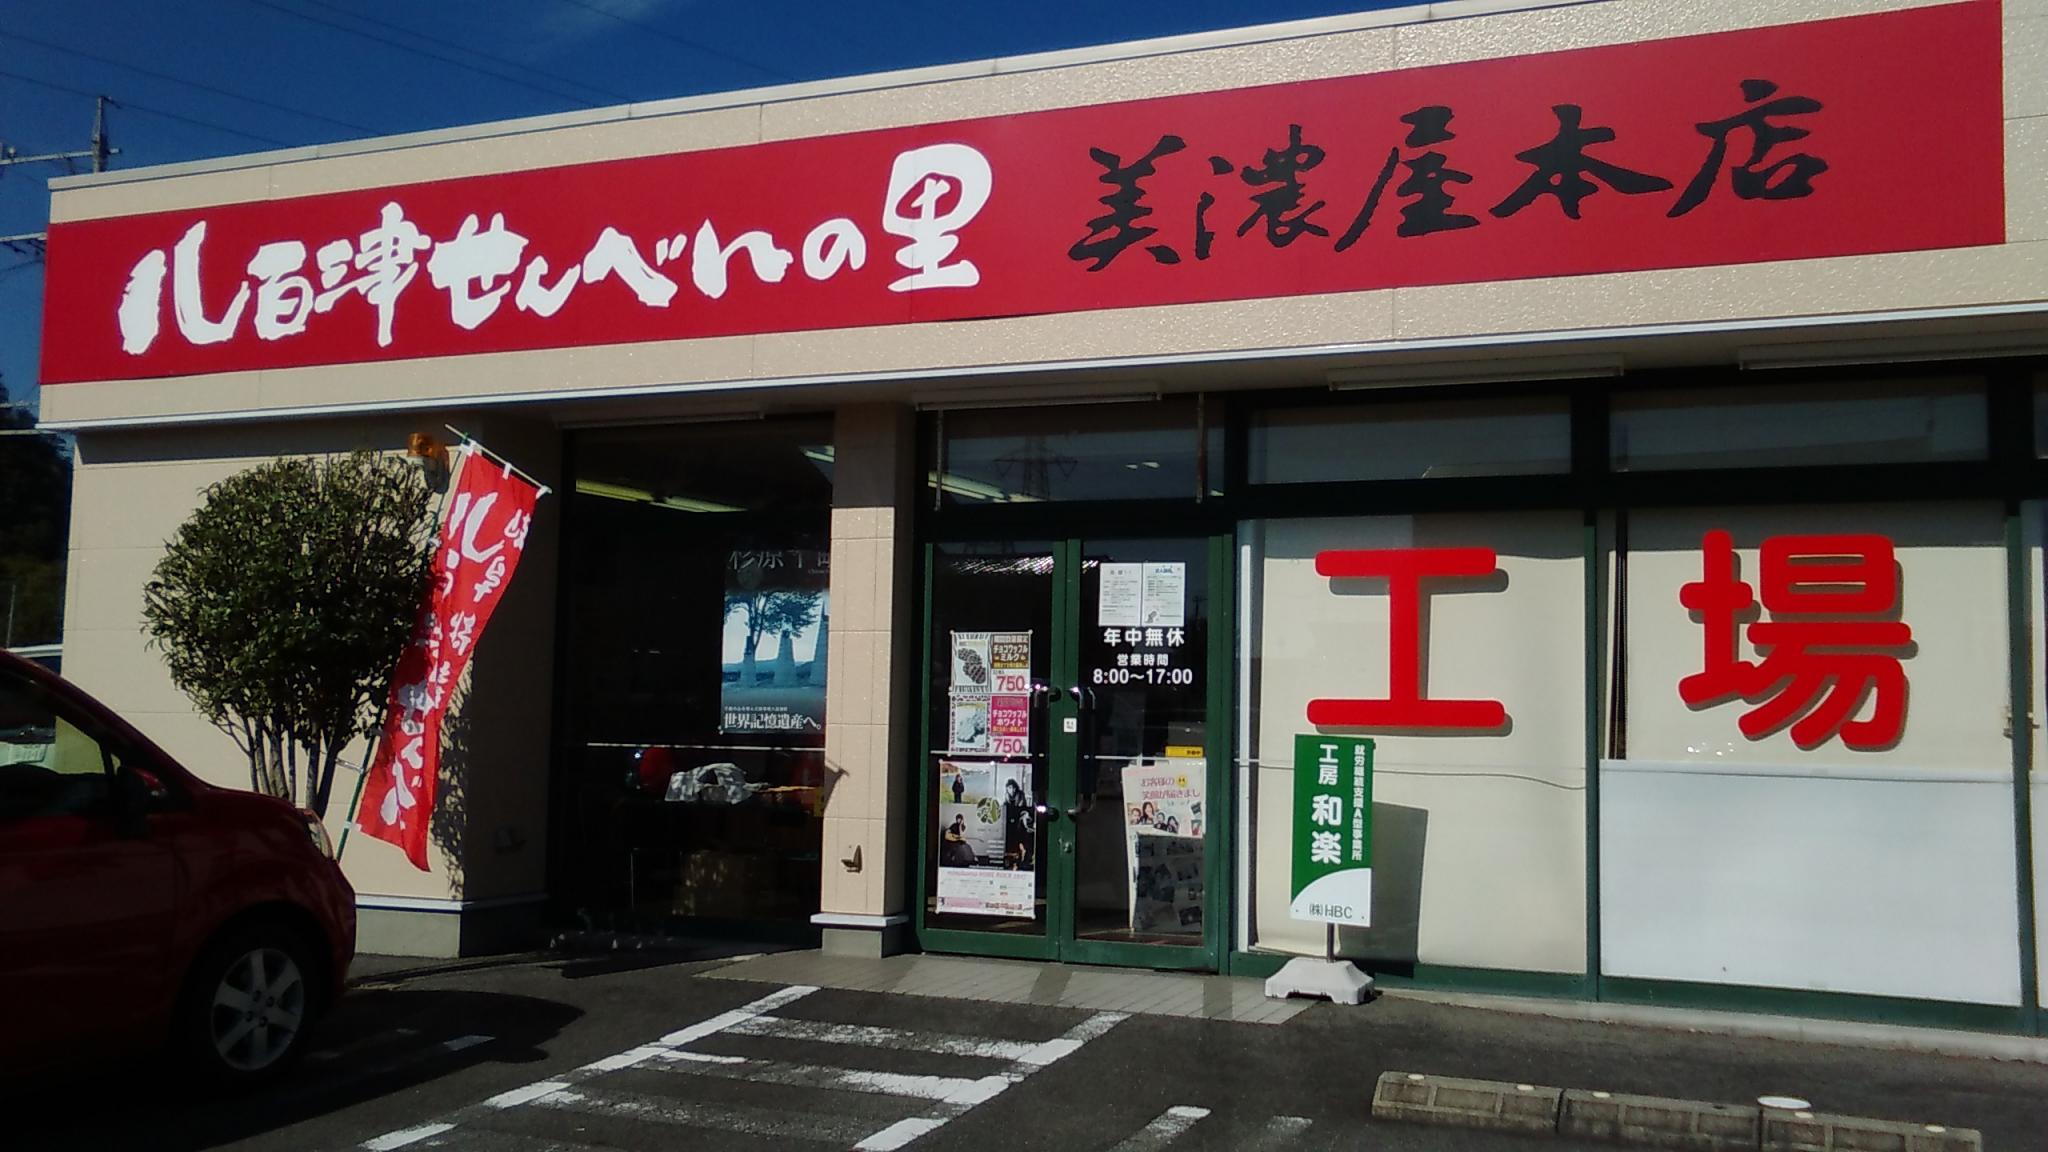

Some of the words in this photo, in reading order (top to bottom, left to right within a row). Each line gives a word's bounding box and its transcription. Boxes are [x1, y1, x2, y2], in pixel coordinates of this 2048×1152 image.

[1067, 79, 1828, 272] 美濃屋本店
[1103, 628, 1185, 647] 年中無休
[1306, 528, 1912, 750] 工場
[1117, 654, 1169, 666] 営業時間
[996, 675, 1025, 692] 750
[1093, 668, 1193, 684] 8:00～17:00
[993, 738, 1022, 754] 750
[1318, 743, 1340, 786] 工房
[1311, 793, 1343, 865] 和楽
